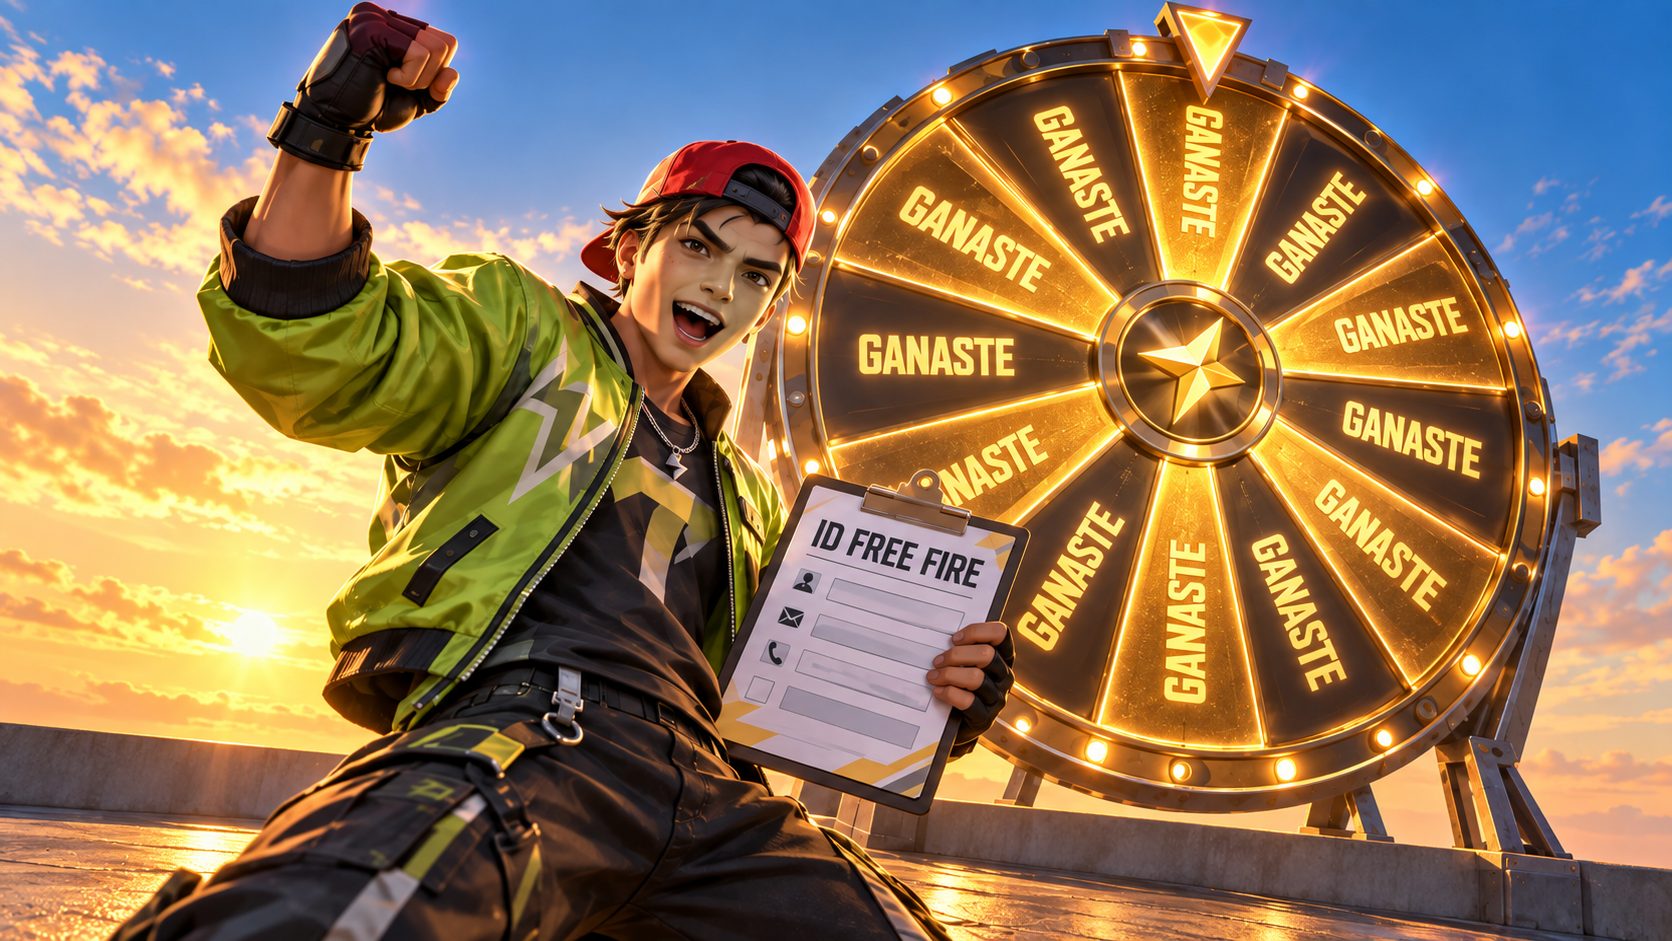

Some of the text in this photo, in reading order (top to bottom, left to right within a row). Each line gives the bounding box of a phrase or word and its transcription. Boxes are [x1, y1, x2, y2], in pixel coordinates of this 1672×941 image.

[1033, 106, 1130, 244] GANASTE
[1180, 104, 1224, 238] GANASTE
[1265, 171, 1367, 285] GANASTE
[899, 185, 1051, 293] GANASTE
[858, 334, 1015, 376] GANASTE
[1334, 297, 1469, 354] GANASTE
[937, 424, 1049, 507] NASTE
[1342, 400, 1482, 479] GANASTE
[811, 518, 985, 589] ID FREE FIRE
[1017, 501, 1125, 651] GANASTE
[1314, 479, 1447, 612] GANASTE
[1163, 539, 1207, 705] GANASTE
[1251, 533, 1347, 692] GANASTE
